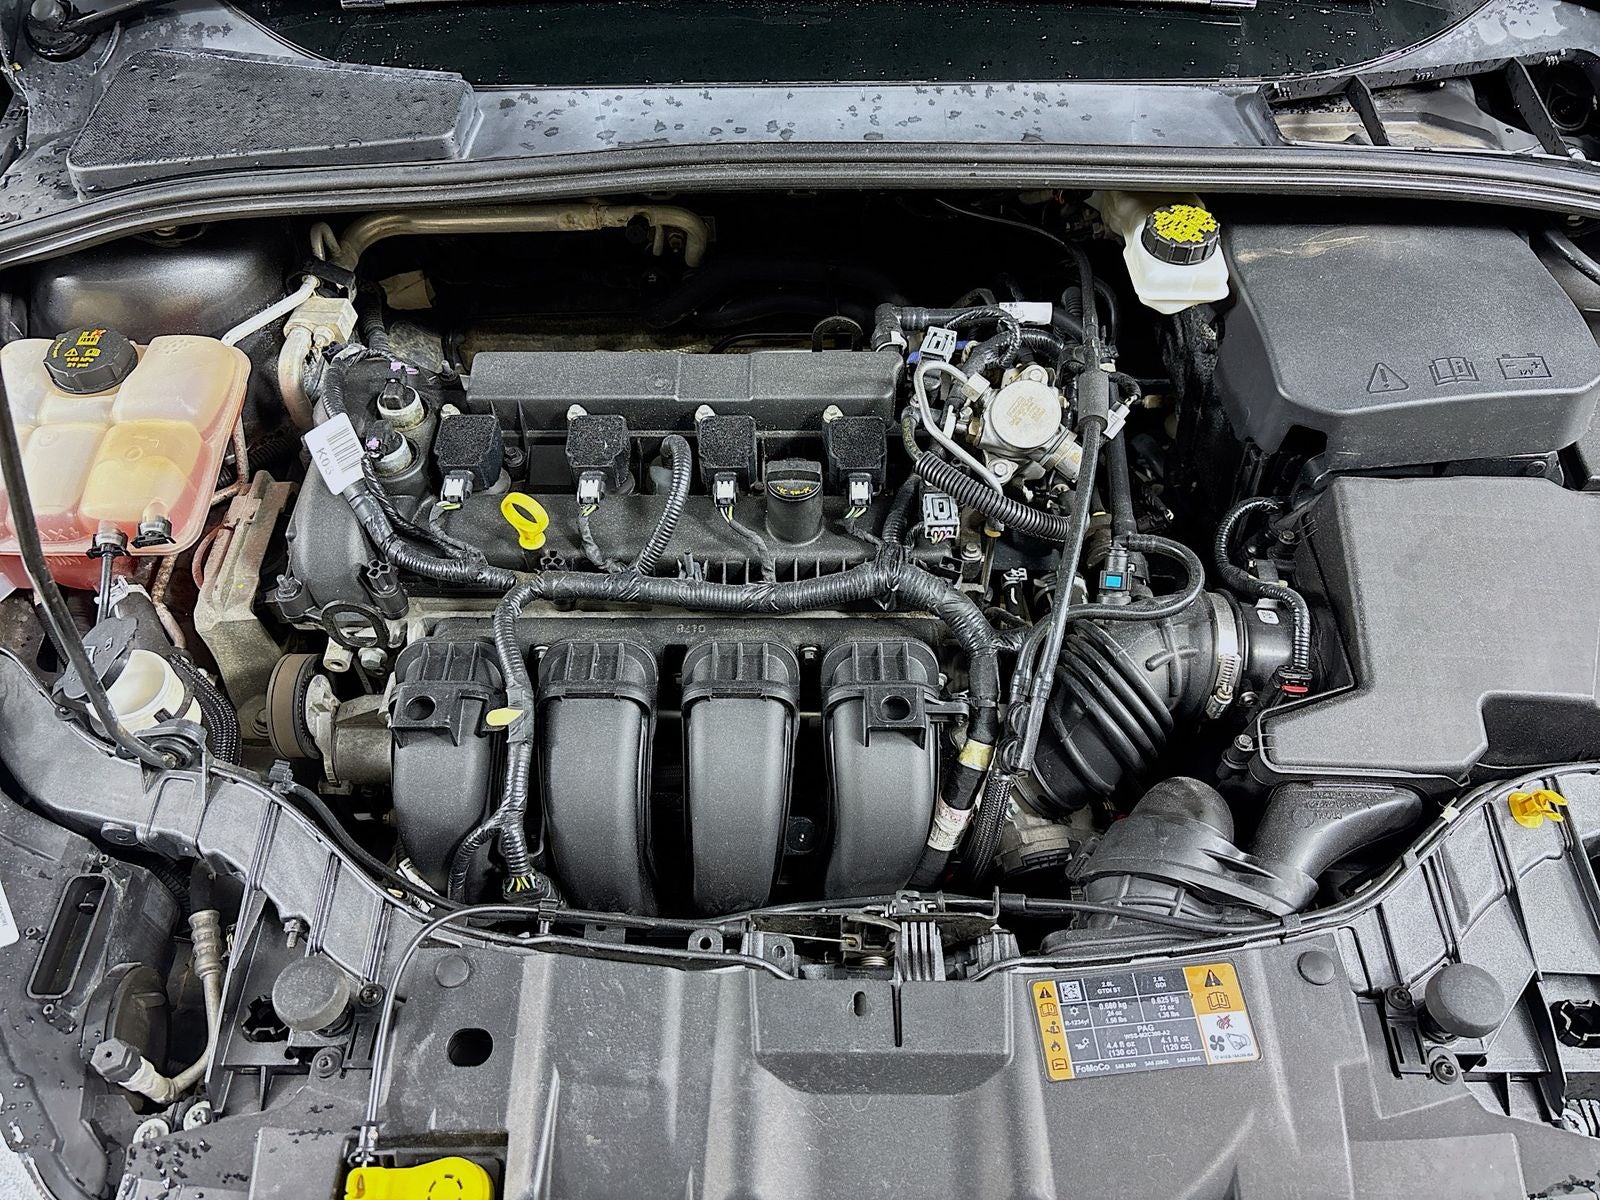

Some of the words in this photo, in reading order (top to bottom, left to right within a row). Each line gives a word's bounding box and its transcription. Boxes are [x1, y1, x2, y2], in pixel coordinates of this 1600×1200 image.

[1118, 1001, 1128, 1009] kg
[1151, 997, 1169, 1005] 0.625
[1170, 996, 1180, 1004] kg
[1065, 1018, 1090, 1027] R-1234yf
[1136, 1024, 1155, 1032] PAG
[1161, 1036, 1172, 1044] 4.1
[1172, 1035, 1179, 1043] fl
[1106, 1041, 1118, 1049] 4.4
[1163, 1042, 1179, 1052] (120
[1180, 1041, 1193, 1050] cc)
[1108, 1049, 1125, 1058] (130
[1125, 1047, 1138, 1056] cc)
[1075, 1063, 1111, 1074] FoMoCo
